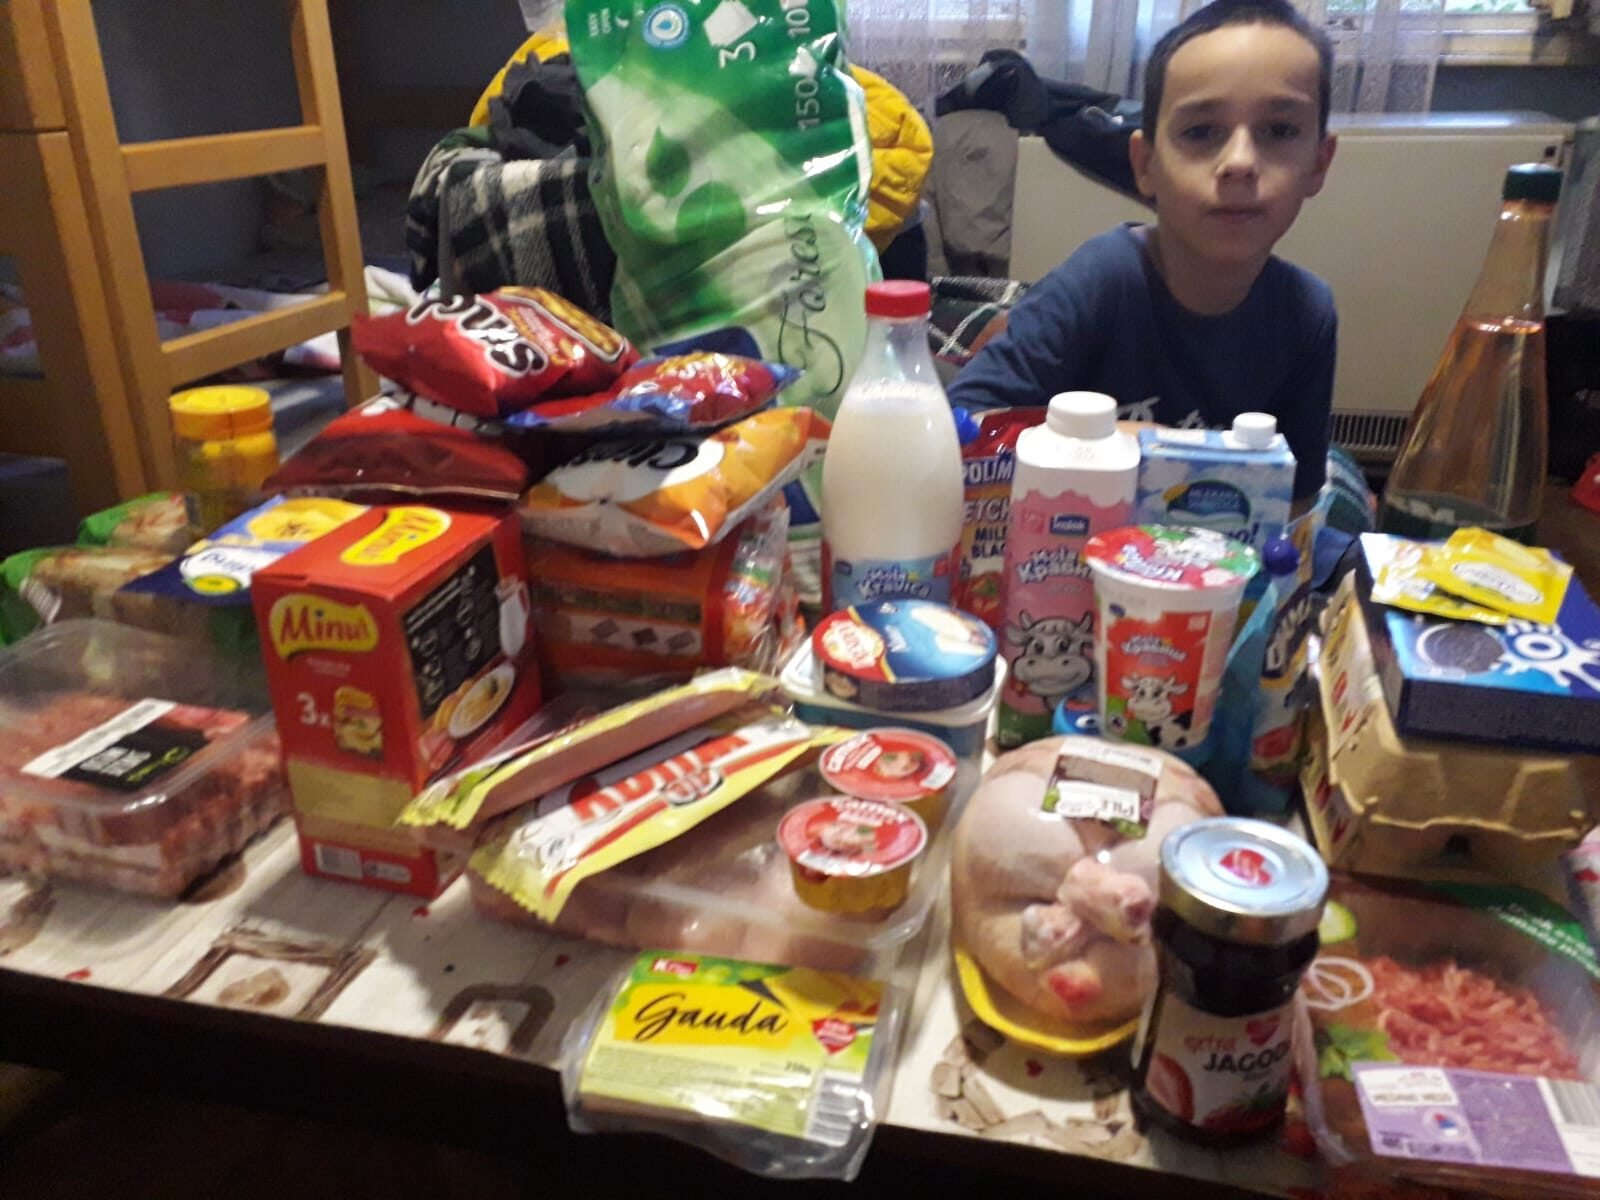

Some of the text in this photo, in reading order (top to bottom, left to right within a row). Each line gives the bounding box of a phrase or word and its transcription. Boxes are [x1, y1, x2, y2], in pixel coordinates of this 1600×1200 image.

[718, 41, 756, 69] 3
[963, 460, 1013, 484] OLIM
[965, 496, 1011, 522] ETCH
[633, 991, 789, 1042] Gauda
[1202, 1039, 1292, 1074] JAGOD
